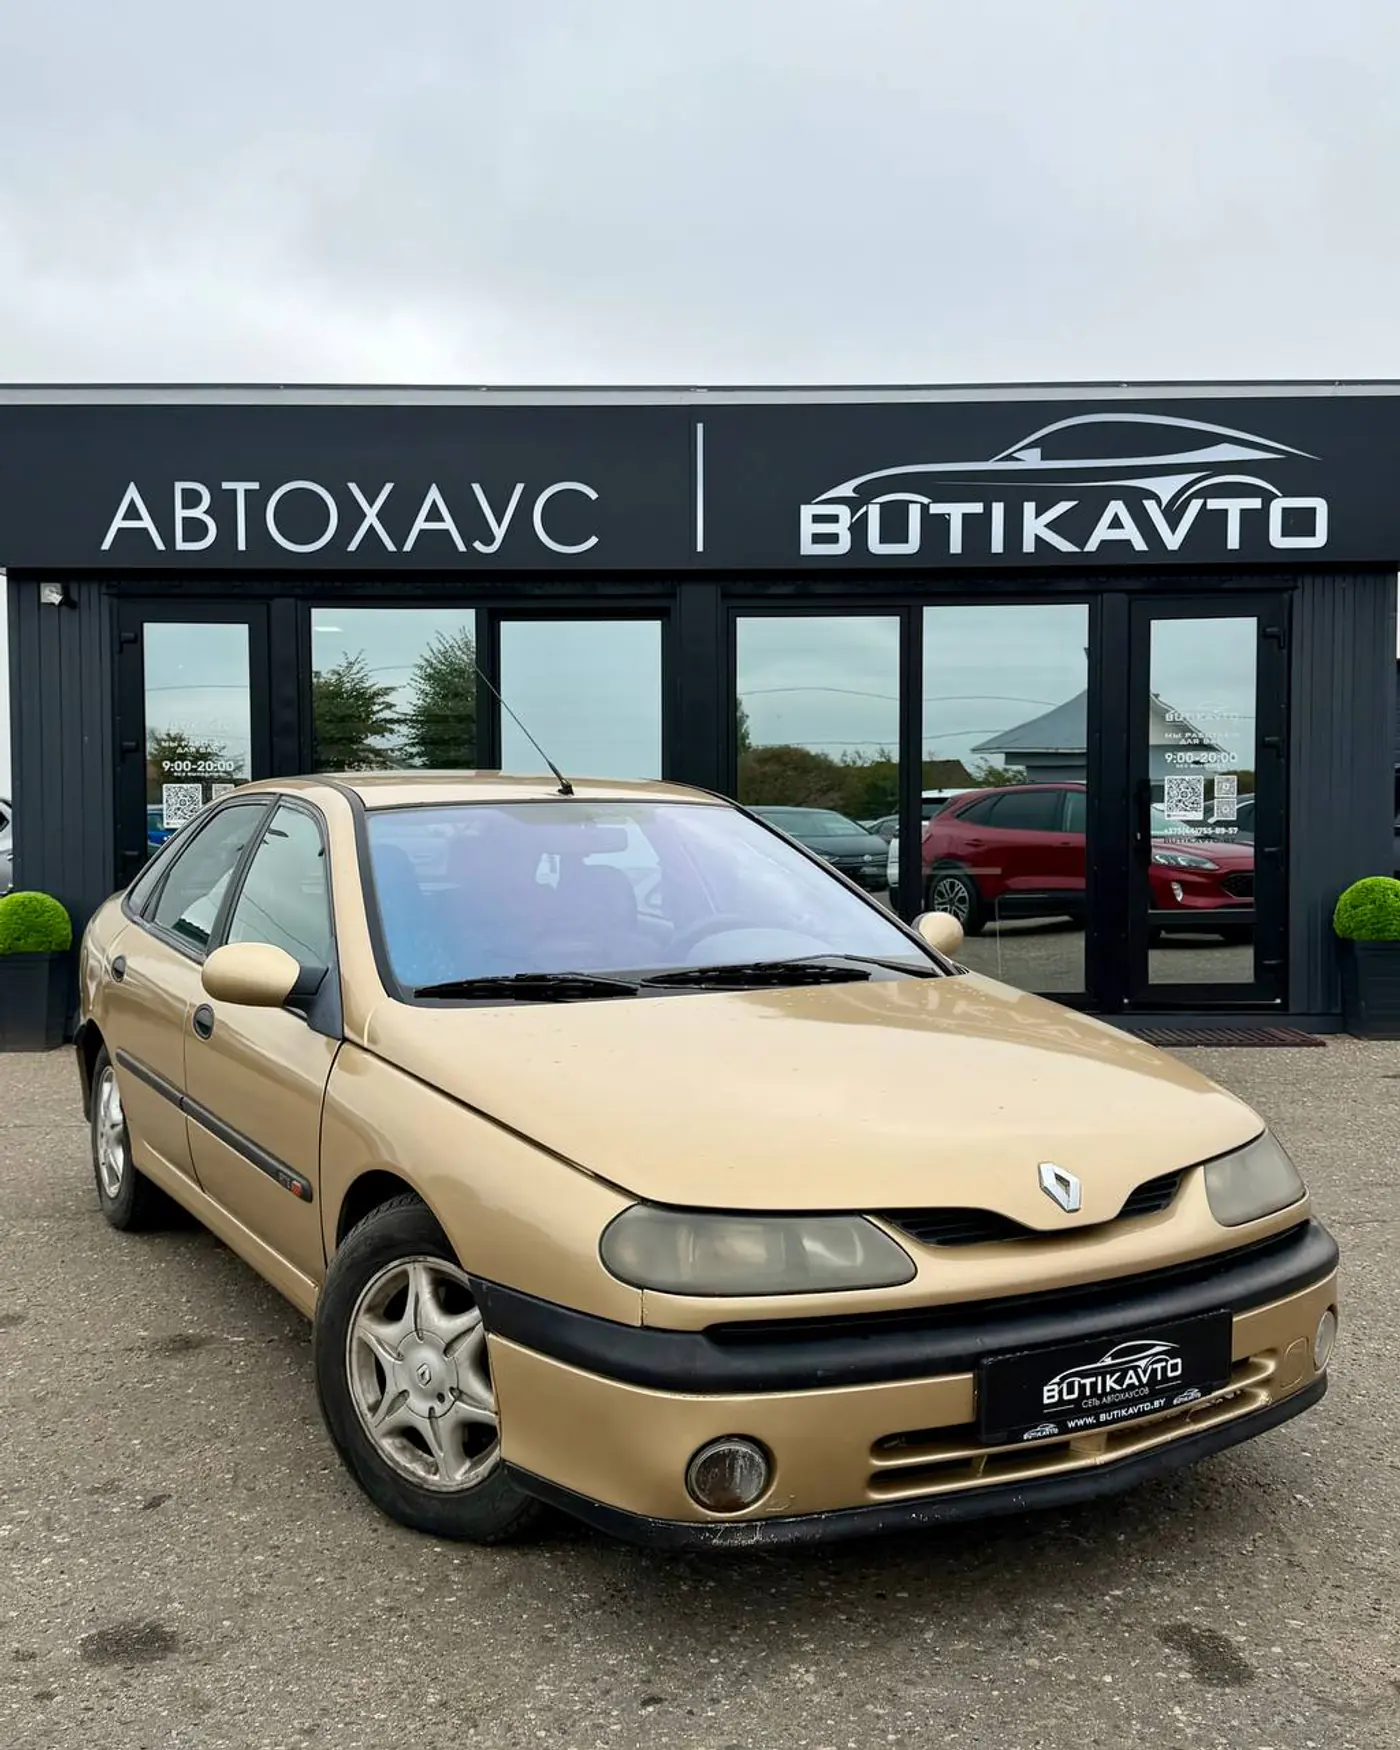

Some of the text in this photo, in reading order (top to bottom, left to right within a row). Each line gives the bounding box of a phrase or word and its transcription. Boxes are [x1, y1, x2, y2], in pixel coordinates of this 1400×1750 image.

[101, 480, 600, 554] АВТОХАУС
[799, 496, 1328, 556] BUTIKAVTO
[161, 760, 234, 772] 9:00-20:00
[1164, 752, 1238, 763] 9:00-20:00
[1043, 1358, 1183, 1405] BUTIKAVTO
[1099, 1397, 1167, 1422] BUTIKAVTO.BY
